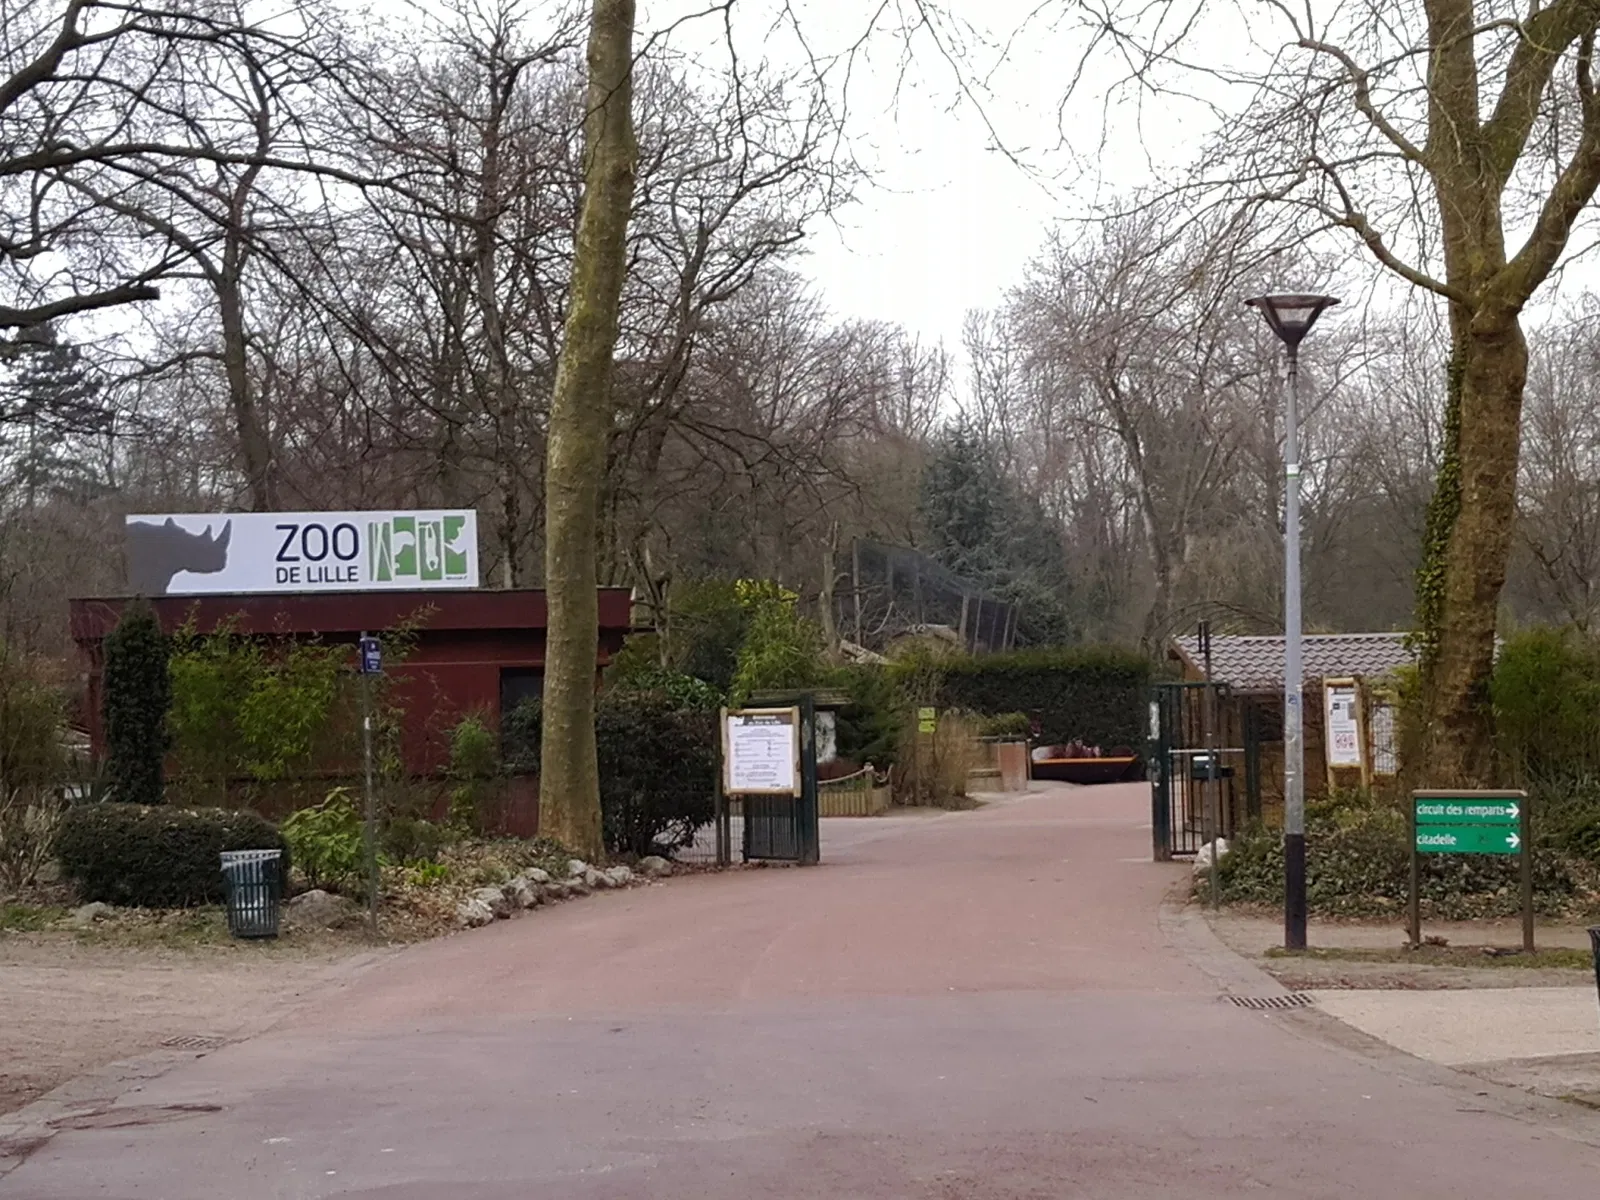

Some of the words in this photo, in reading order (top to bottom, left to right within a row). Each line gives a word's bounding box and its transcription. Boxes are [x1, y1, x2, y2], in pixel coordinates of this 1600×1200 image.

[275, 523, 360, 562] ZOO
[276, 567, 301, 583] DE
[307, 566, 359, 582] LILLE
[1416, 804, 1444, 815] circuit
[1446, 804, 1463, 815] des
[1465, 805, 1505, 818] remparts
[1416, 833, 1457, 845] citadelle
